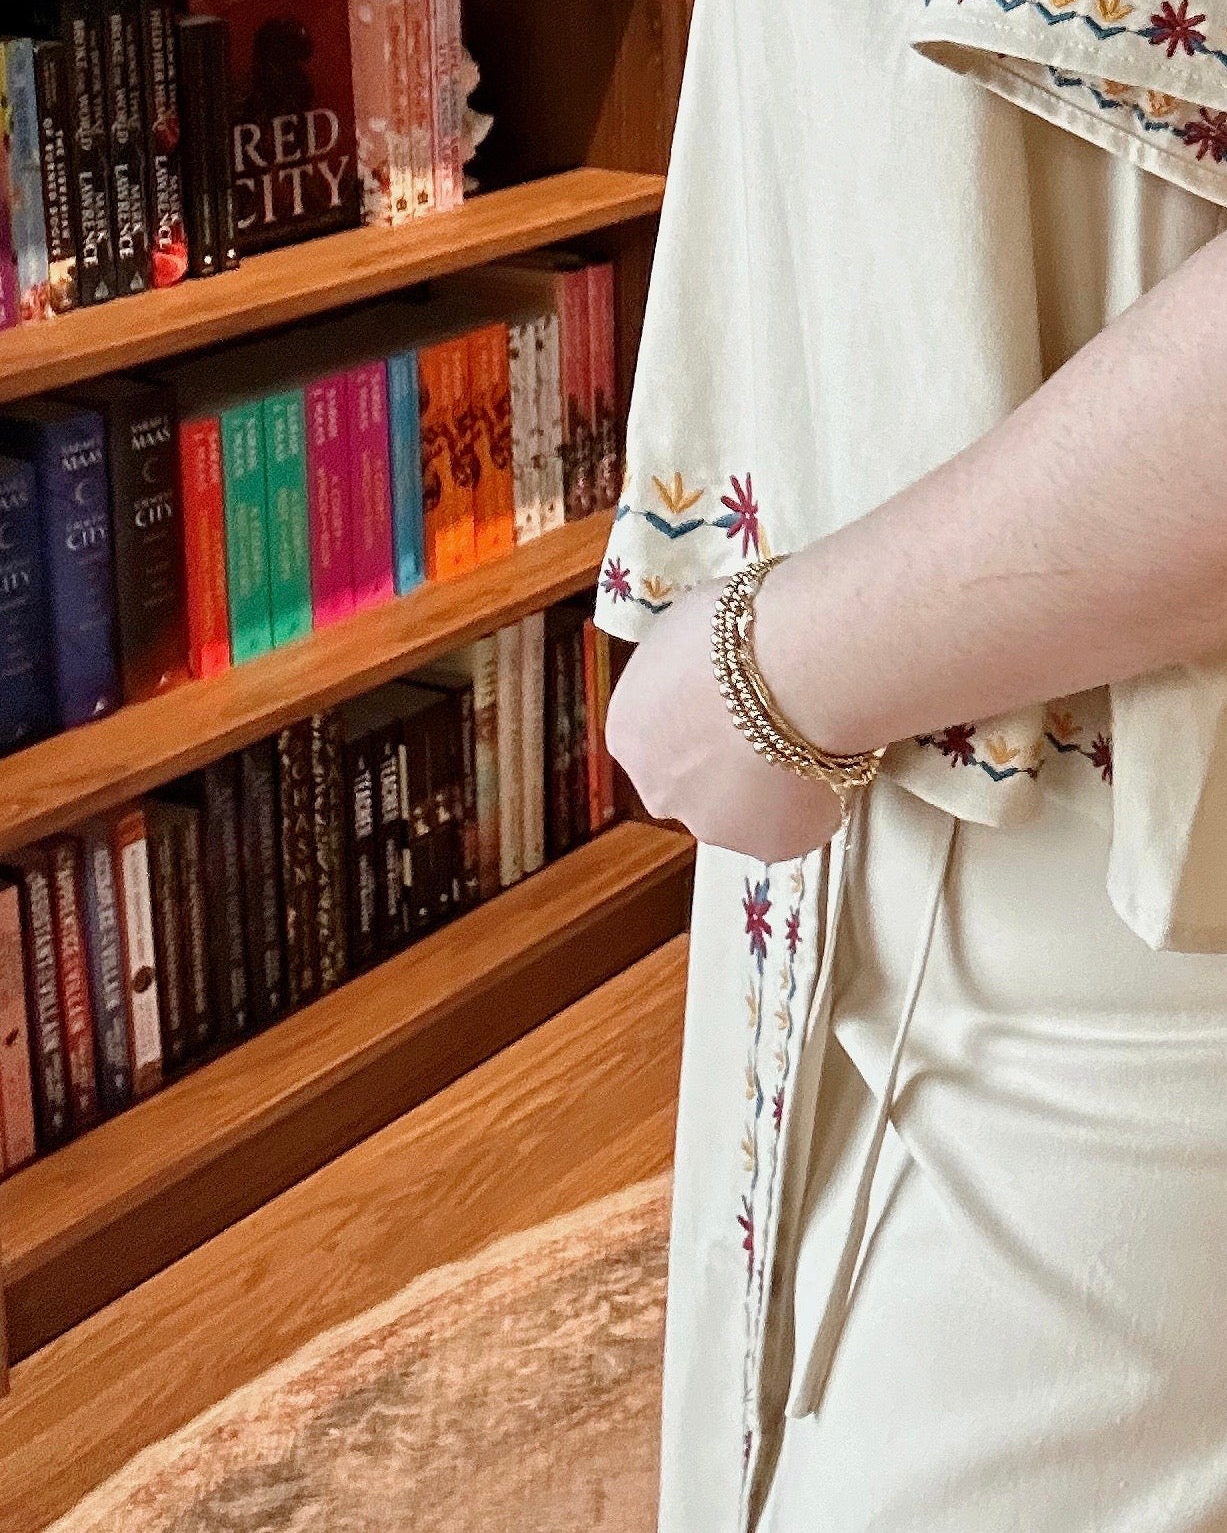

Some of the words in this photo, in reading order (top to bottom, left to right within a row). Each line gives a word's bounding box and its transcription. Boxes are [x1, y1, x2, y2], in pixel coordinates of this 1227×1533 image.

[233, 108, 340, 172] RED
[79, 171, 99, 267] LAWRENCE
[114, 165, 134, 259] LAWRENCE
[154, 155, 170, 249] LAWRENCE
[235, 156, 350, 230] CITY
